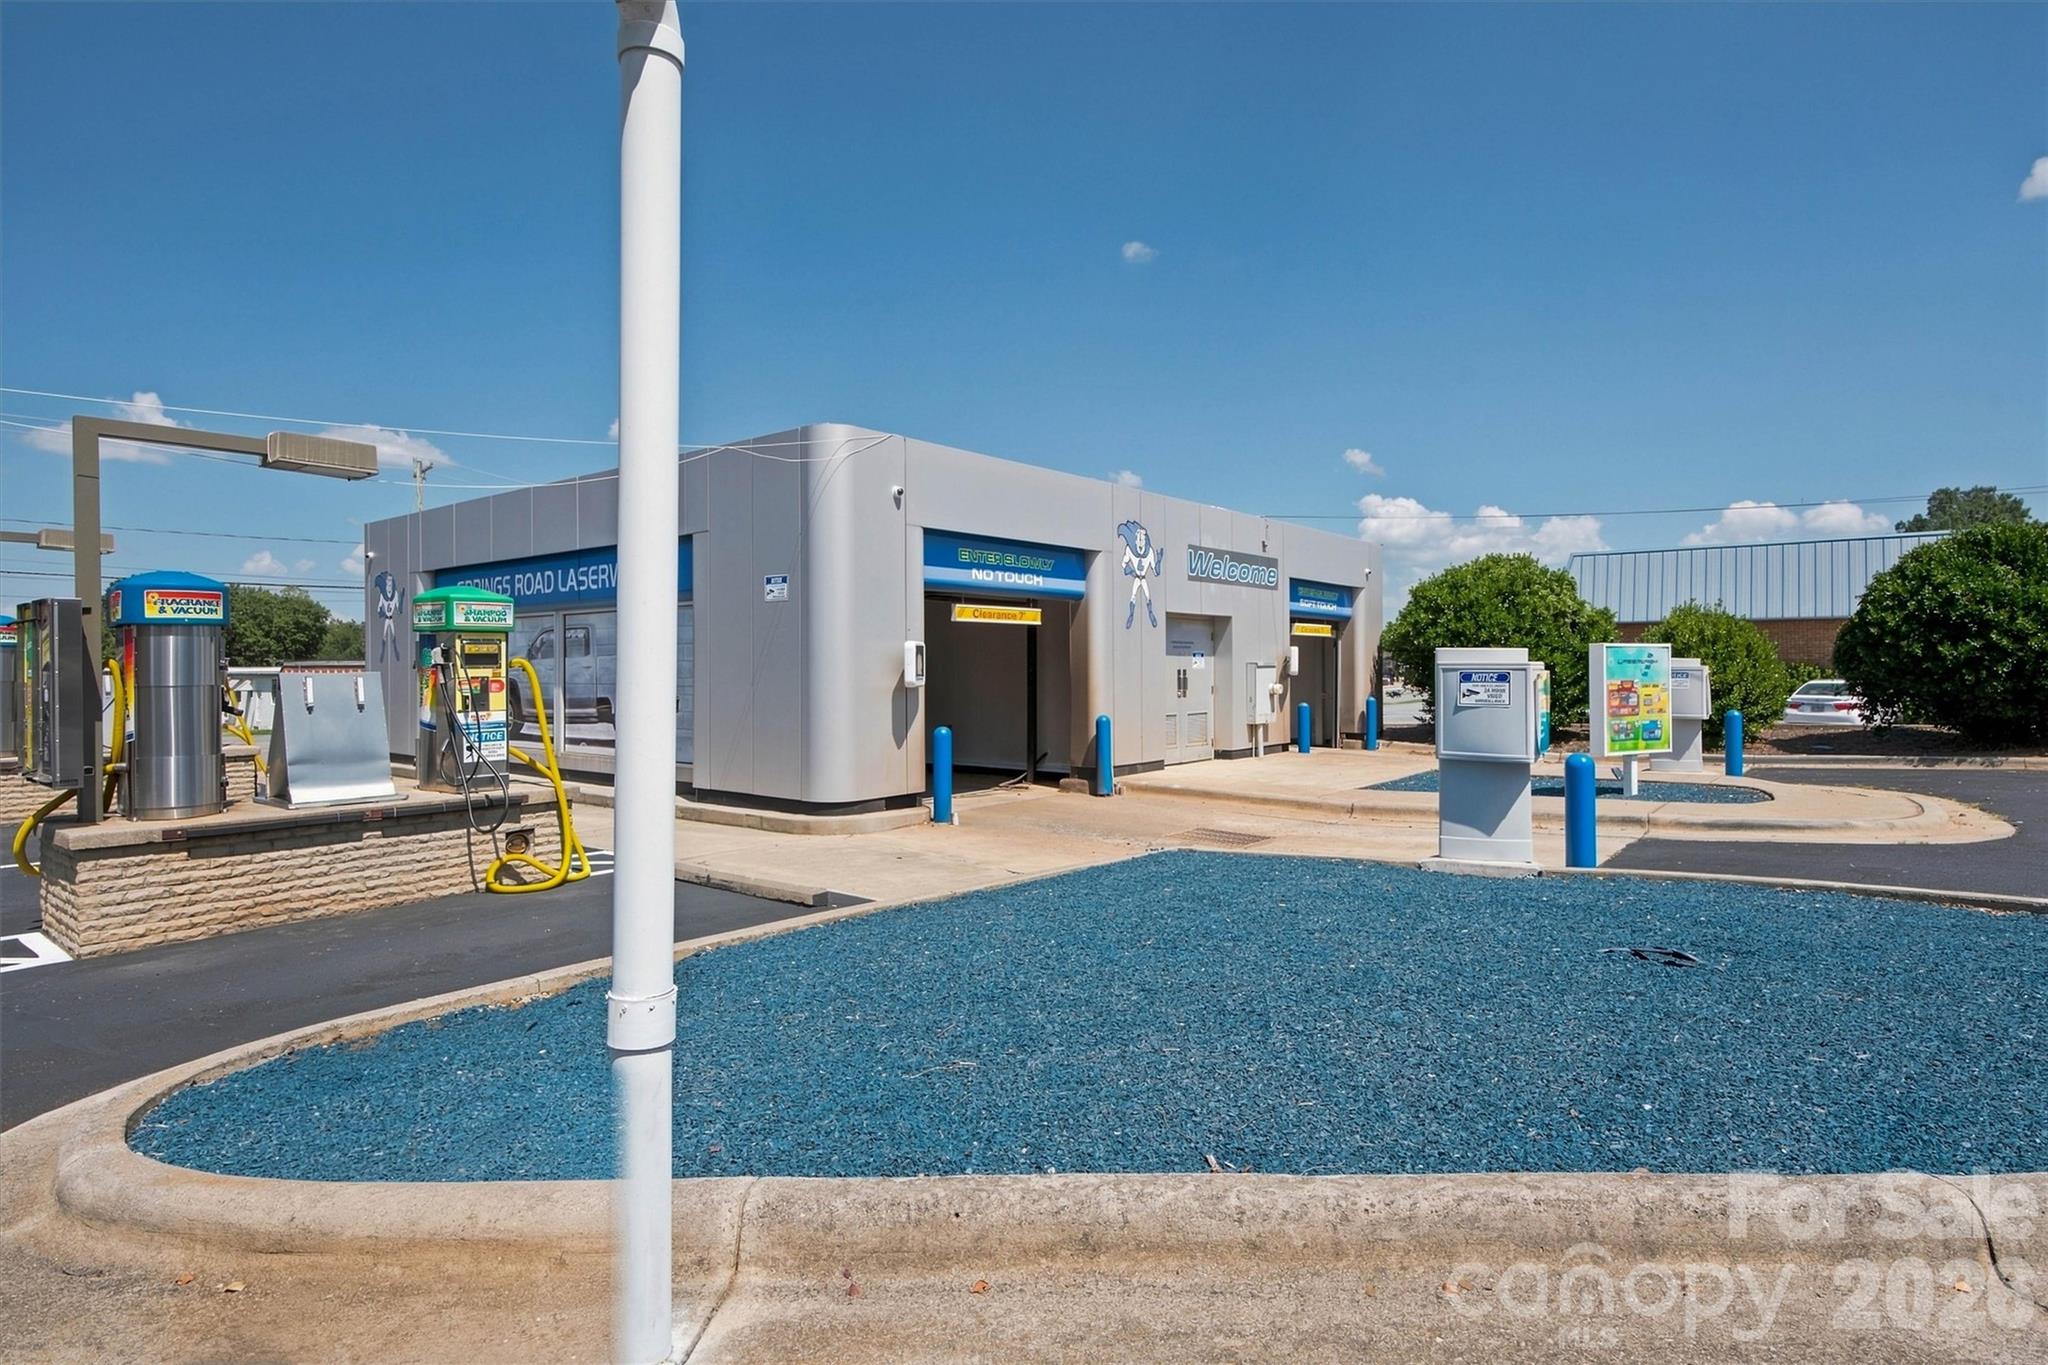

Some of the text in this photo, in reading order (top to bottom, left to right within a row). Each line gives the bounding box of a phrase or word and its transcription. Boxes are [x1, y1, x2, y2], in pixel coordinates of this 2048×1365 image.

[958, 548, 1002, 566] ENTER
[1187, 548, 1278, 586] Welcome
[456, 575, 511, 597] INGS
[515, 571, 554, 596] ROAD
[971, 568, 1043, 585] NO TOUCH
[170, 607, 218, 615] VACUUM
[472, 615, 507, 623] VACUUM
[972, 608, 1017, 620] Clearance
